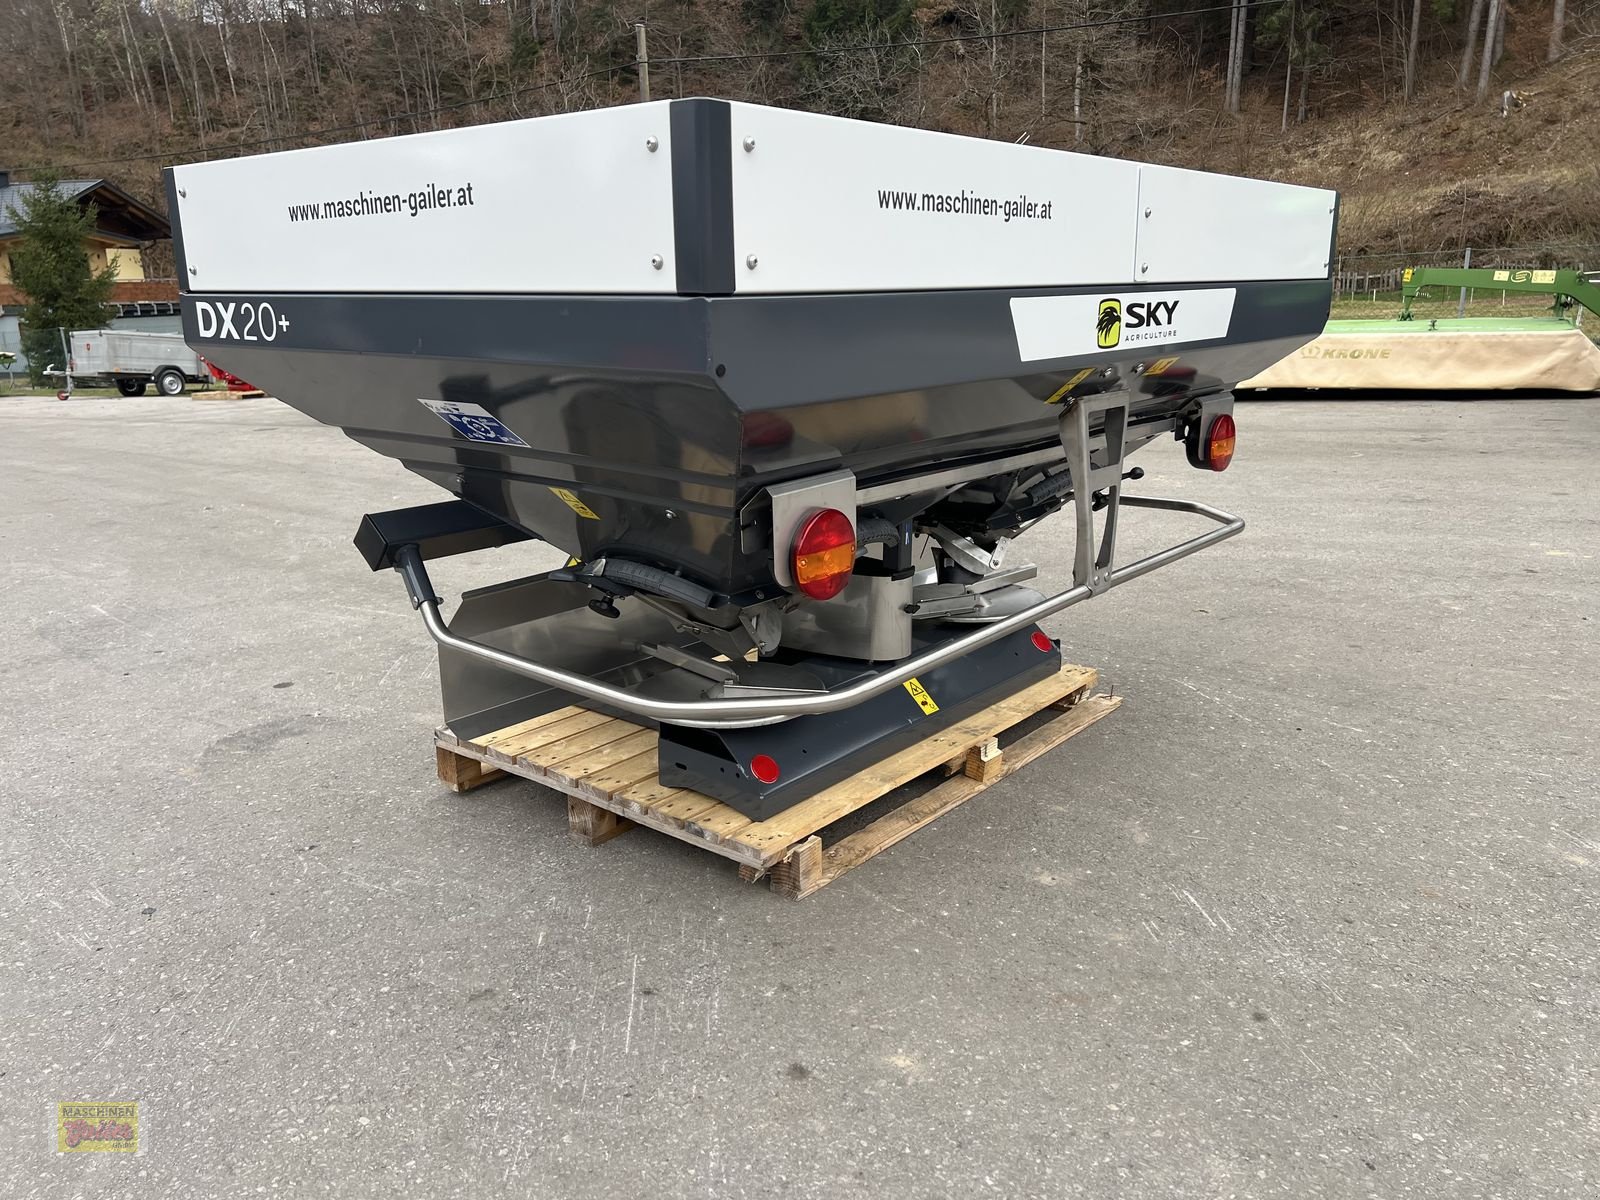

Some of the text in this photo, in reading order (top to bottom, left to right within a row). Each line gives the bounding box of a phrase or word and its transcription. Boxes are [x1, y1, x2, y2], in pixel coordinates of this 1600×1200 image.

[288, 182, 474, 222] www.maschinen-gailer.at
[877, 189, 1052, 222] www.maschinen-gailer.at
[1125, 300, 1180, 328] SKY
[1125, 330, 1177, 342] AGRICULTURE
[1321, 348, 1392, 359] KRONE
